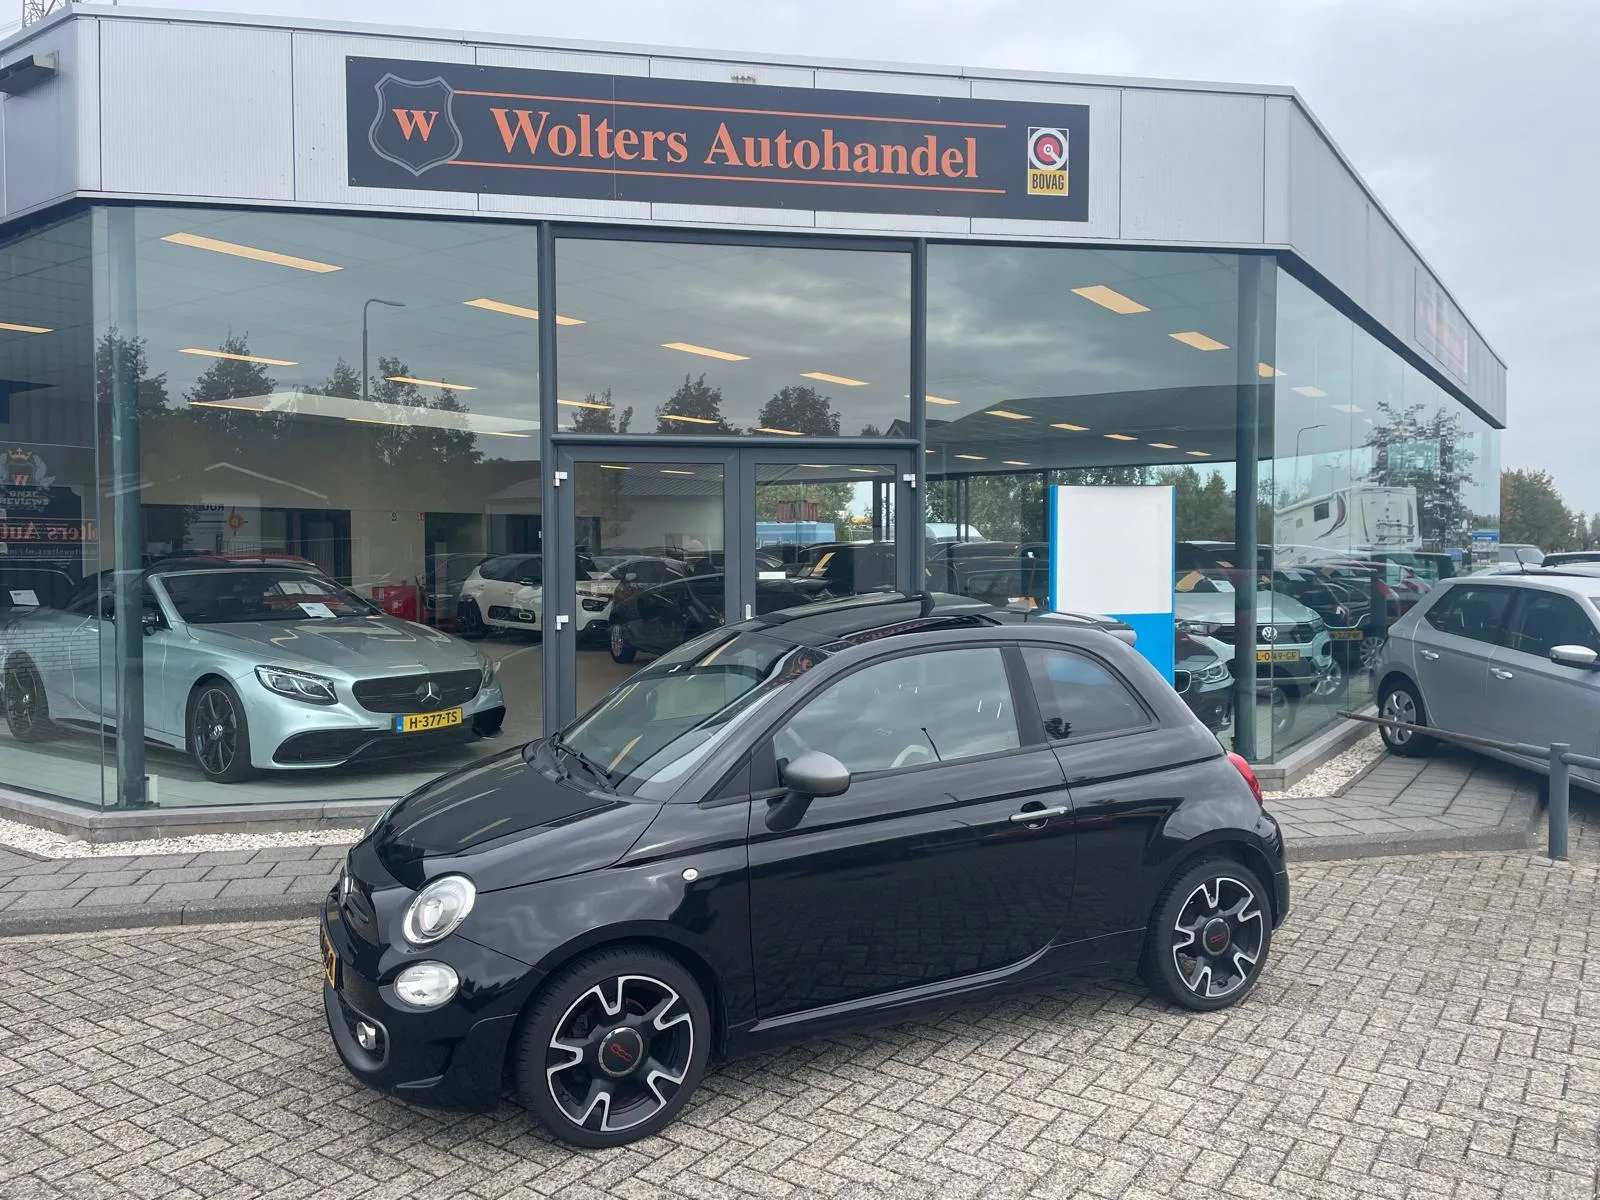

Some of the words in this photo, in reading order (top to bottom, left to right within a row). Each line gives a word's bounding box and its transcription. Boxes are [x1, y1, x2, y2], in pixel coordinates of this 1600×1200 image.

[392, 108, 439, 142] W
[489, 108, 688, 163] Wolters
[704, 121, 980, 178] Autohandel
[1032, 173, 1065, 191] BOVAG
[409, 711, 458, 729] H-377-TS
